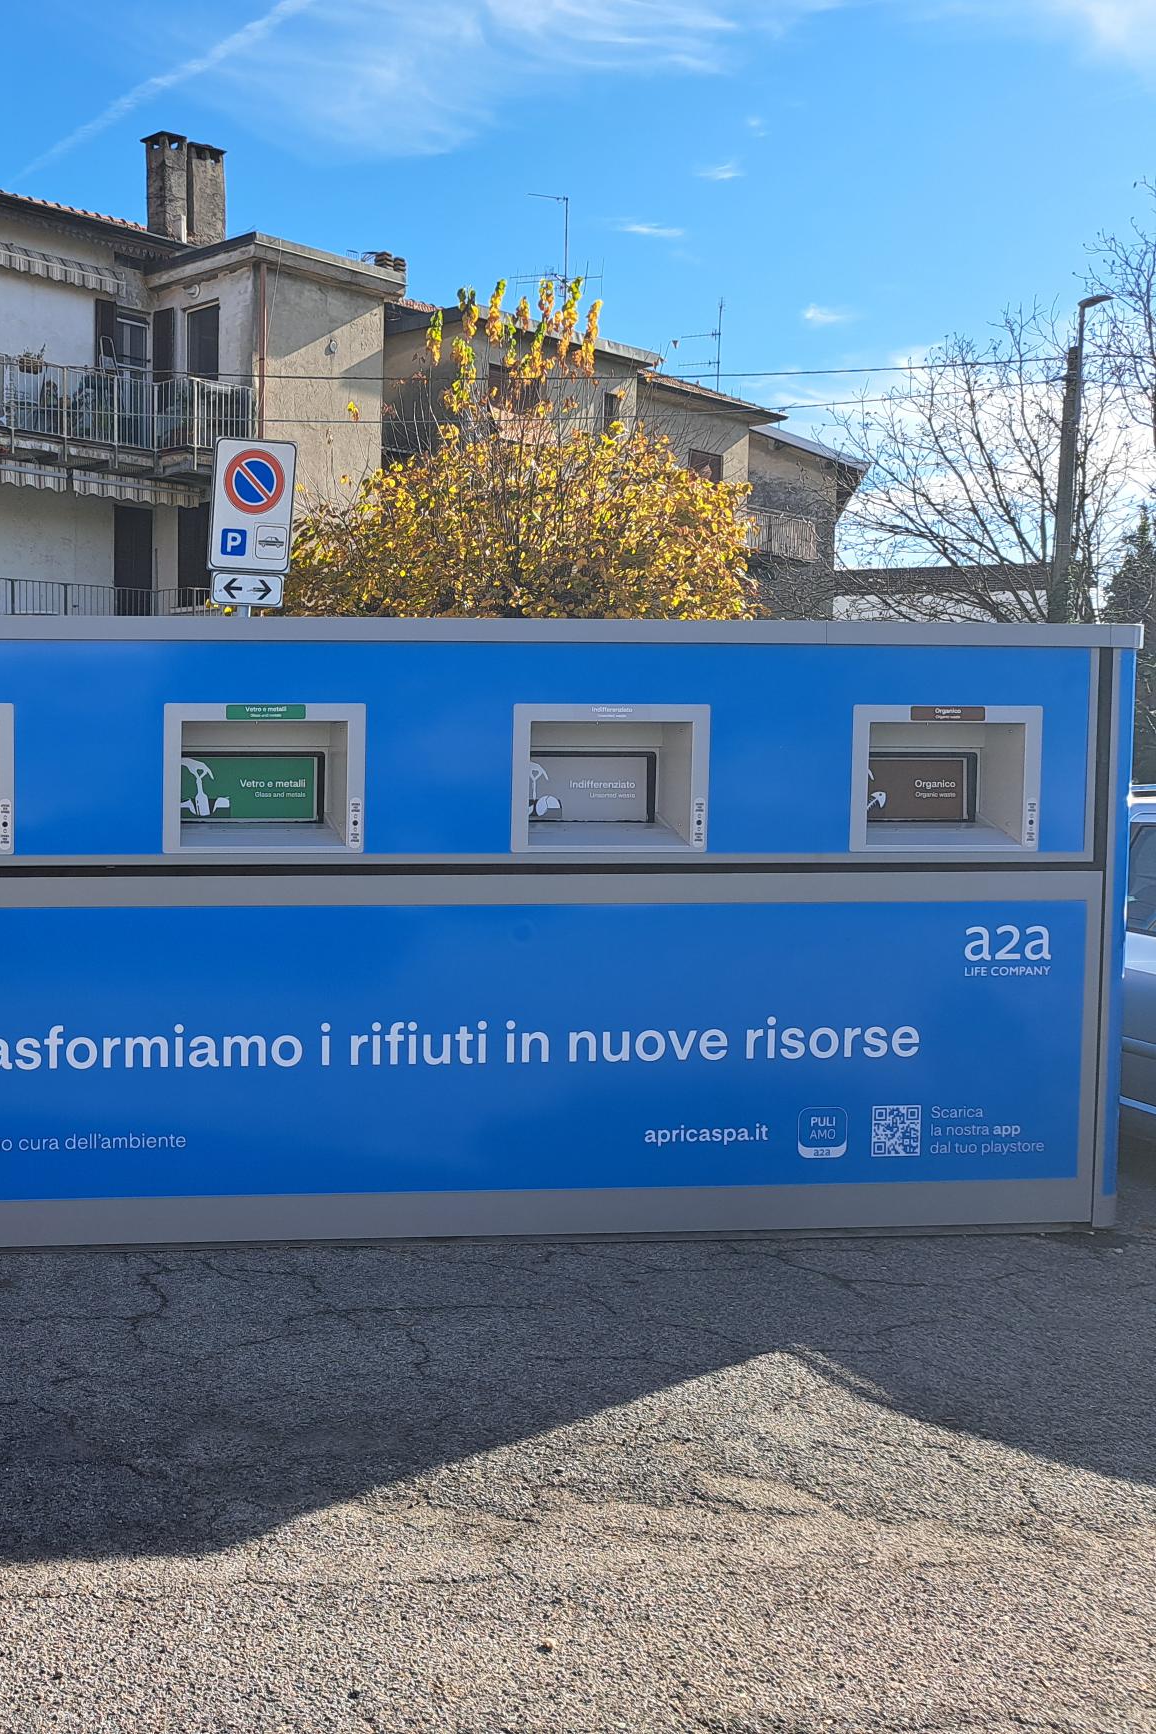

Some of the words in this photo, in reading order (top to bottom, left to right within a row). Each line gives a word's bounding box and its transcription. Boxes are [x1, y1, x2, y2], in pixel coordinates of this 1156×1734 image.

[226, 532, 242, 552] P
[934, 707, 962, 715] Organico
[239, 779, 265, 788] Vetro
[275, 779, 306, 788] metalli
[569, 780, 636, 789] Indifferenziato
[914, 780, 956, 789] Organico
[915, 791, 939, 799] Organic
[964, 924, 1052, 962] a2a
[964, 966, 988, 977] LIFE
[990, 965, 1051, 977] COMPANY
[320, 1022, 331, 1066] i
[350, 1020, 488, 1066] rifiuti
[505, 1019, 550, 1064] in
[568, 1028, 728, 1063] nuove
[745, 1016, 920, 1060] risorse
[930, 1105, 984, 1119] Scarica
[810, 1116, 836, 1127] PULI
[644, 1123, 769, 1147] apricaspa.it
[809, 1128, 836, 1140] AMO
[930, 1123, 942, 1137] la
[946, 1124, 990, 1136] nostra
[992, 1124, 1021, 1139] app
[18, 1138, 60, 1151] cura
[930, 1140, 951, 1154] dal
[954, 1141, 978, 1154] tuo
[981, 1140, 1045, 1156] playstore
[813, 1149, 831, 1157] a2a
